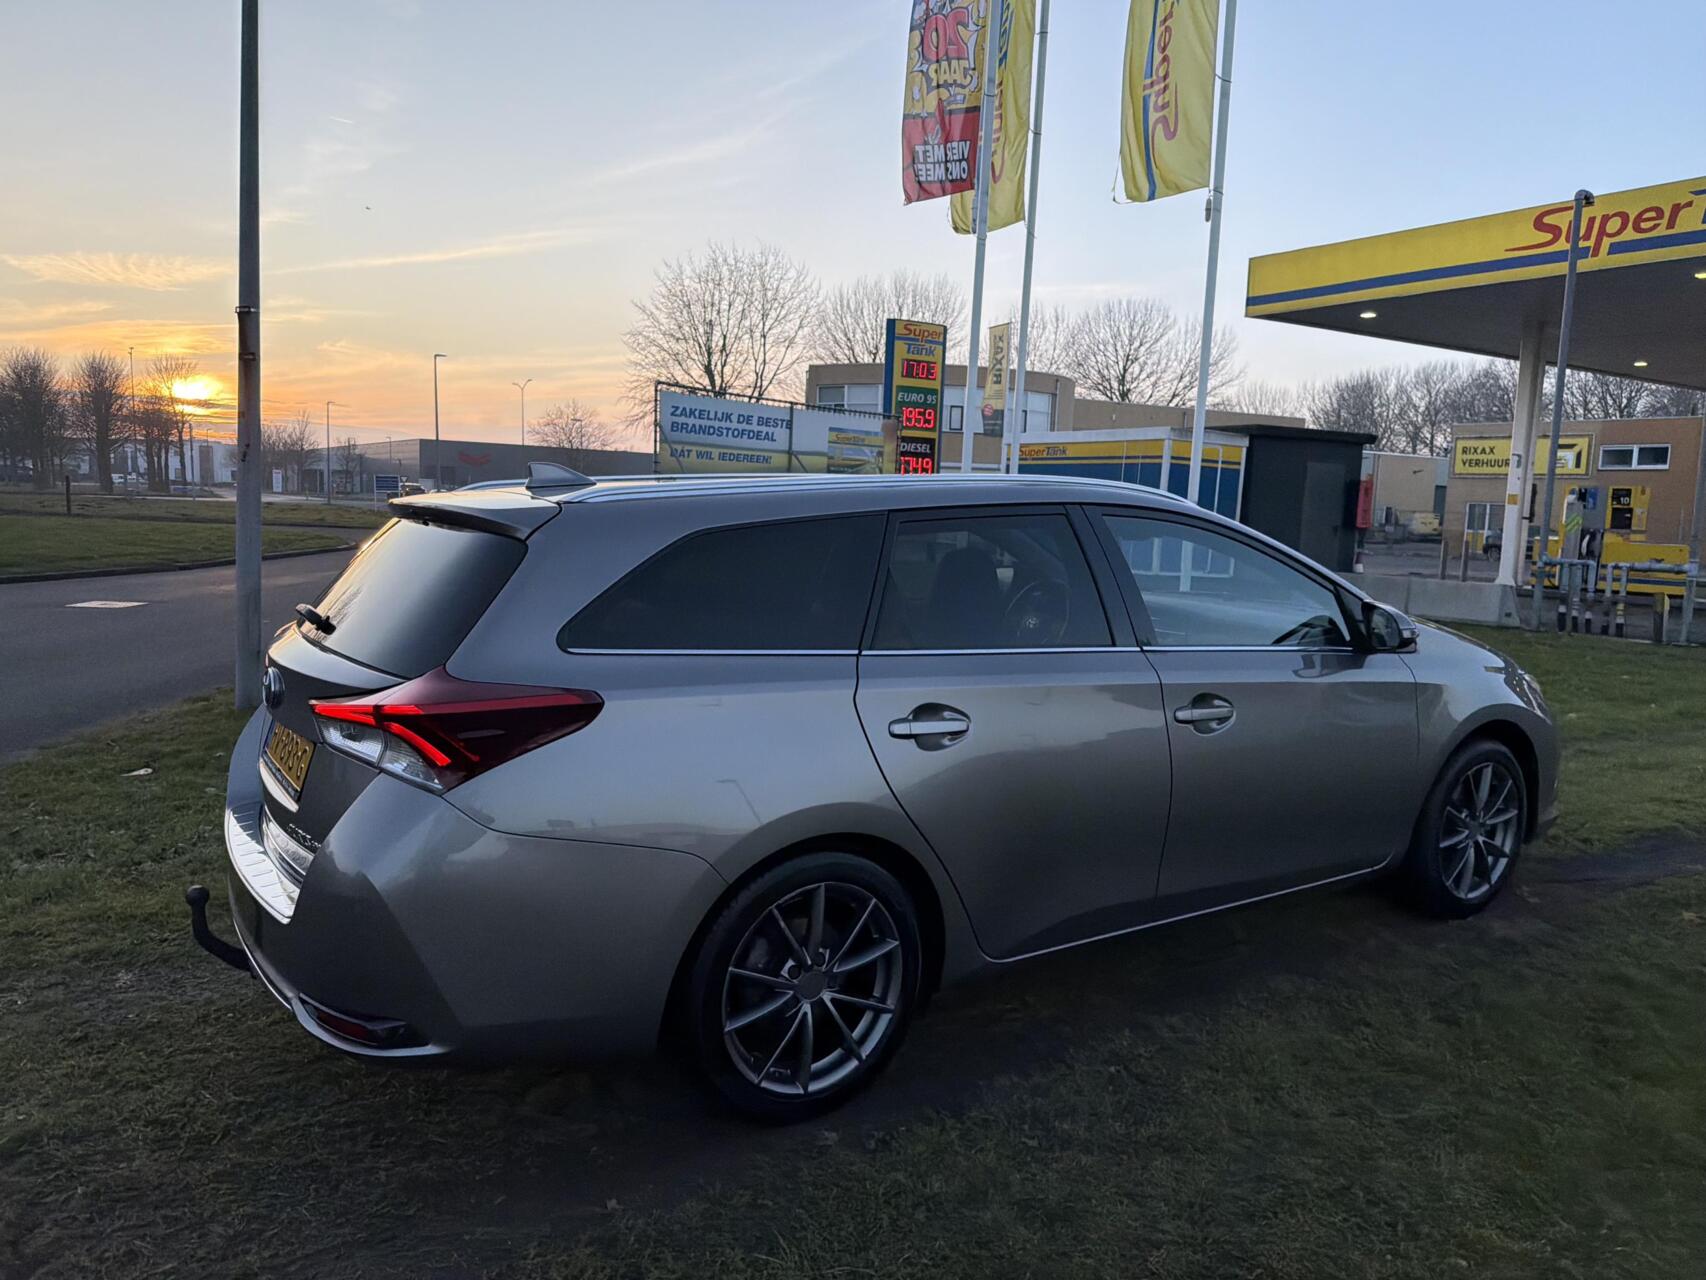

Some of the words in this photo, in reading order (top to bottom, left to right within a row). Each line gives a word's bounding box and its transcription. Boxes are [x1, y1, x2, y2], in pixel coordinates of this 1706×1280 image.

[896, 323, 942, 343] Super
[904, 343, 936, 357] Tank
[898, 393, 924, 402] EURO
[926, 395, 937, 404] 95
[670, 405, 734, 424] ZAKELIJK
[737, 413, 754, 425] DE
[757, 416, 792, 430] BESTE
[670, 421, 777, 442] BRANDSTOFDEAL
[900, 442, 931, 453] DIESEL
[1461, 446, 1496, 456] RIXAX
[696, 450, 714, 460] WIL
[718, 452, 773, 465] IEDEREEN!
[1461, 458, 1510, 468] VERHUUR
[1620, 497, 1630, 505] 10
